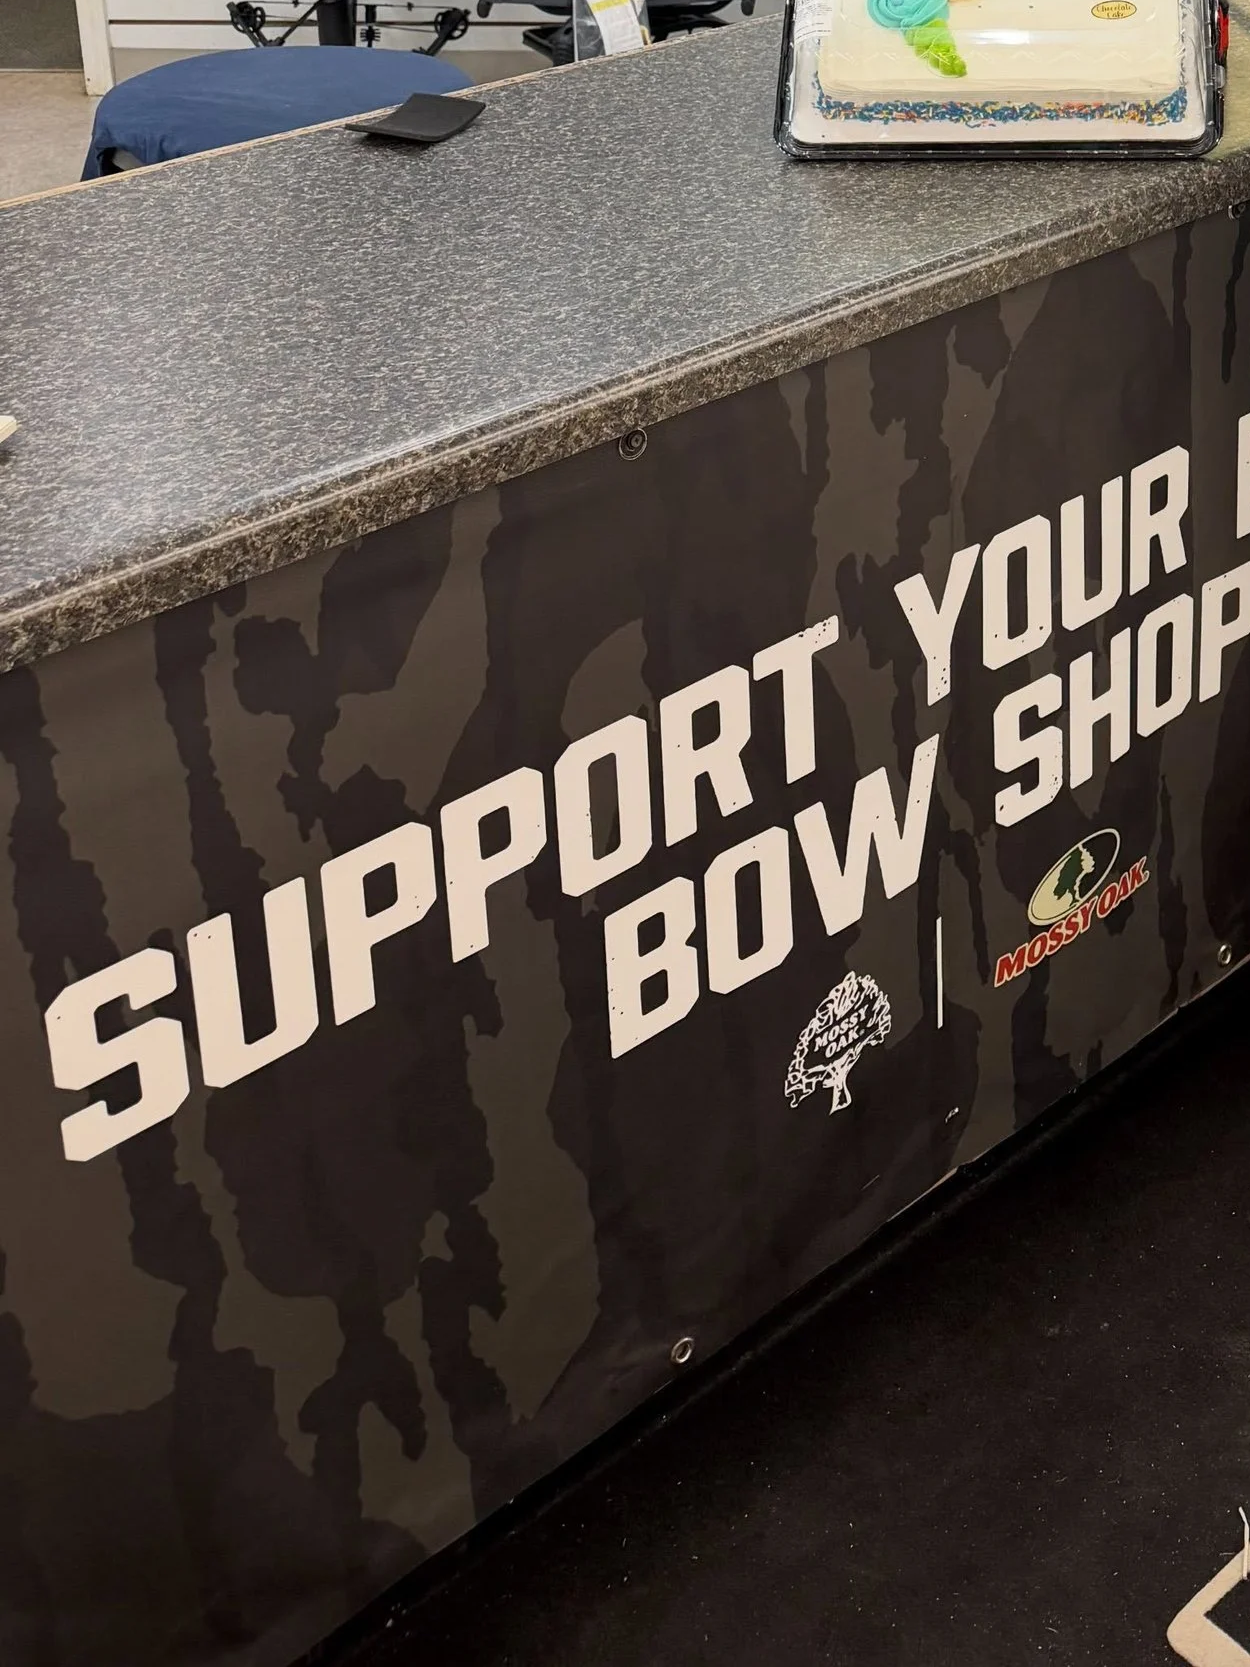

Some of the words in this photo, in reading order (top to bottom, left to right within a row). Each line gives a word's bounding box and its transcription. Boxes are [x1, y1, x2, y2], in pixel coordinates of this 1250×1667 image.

[44, 615, 839, 1162] SUPPORT
[894, 445, 1189, 706] YOUR
[605, 734, 939, 1058] BOW
[994, 896, 1098, 988] MOSSY
[1096, 856, 1147, 918] OAK
[814, 1004, 869, 1052] MOSSY
[825, 1028, 860, 1058] OAK
